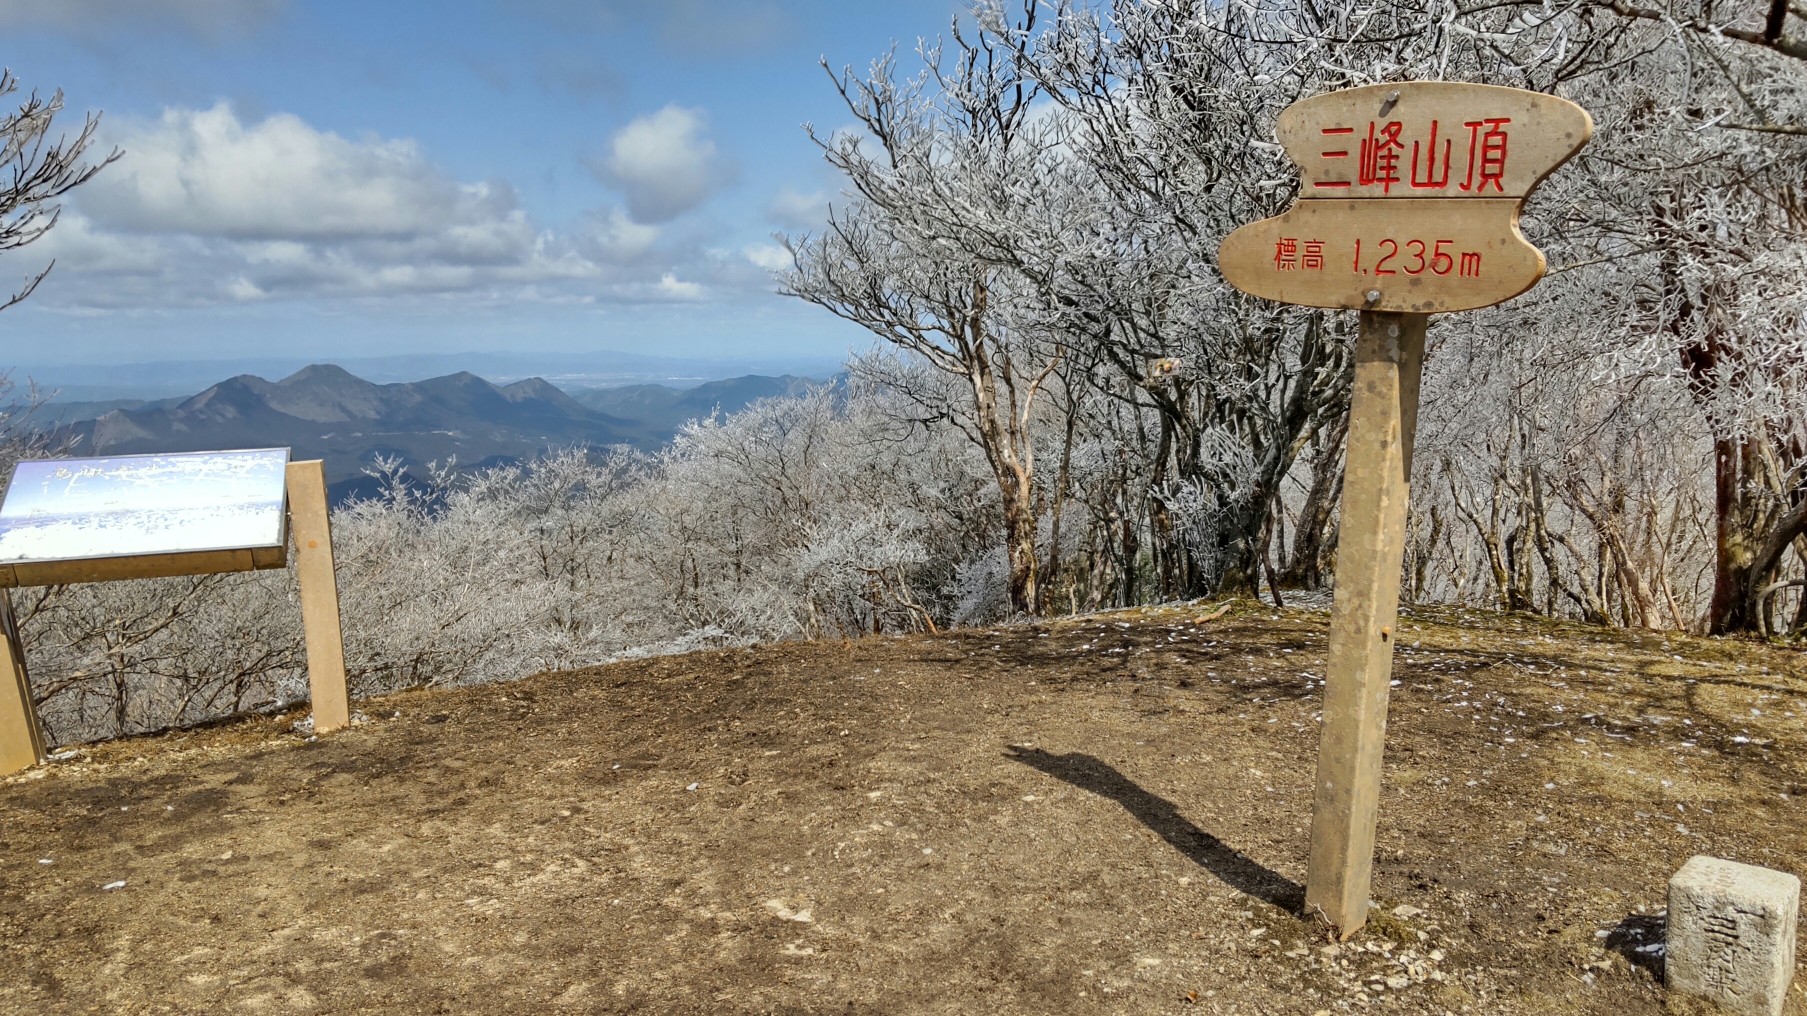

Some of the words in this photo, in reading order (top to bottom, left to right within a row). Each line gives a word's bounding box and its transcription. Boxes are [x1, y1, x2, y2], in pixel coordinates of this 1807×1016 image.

[1313, 117, 1512, 195] 三峰山頂
[1273, 237, 1326, 271] 標高
